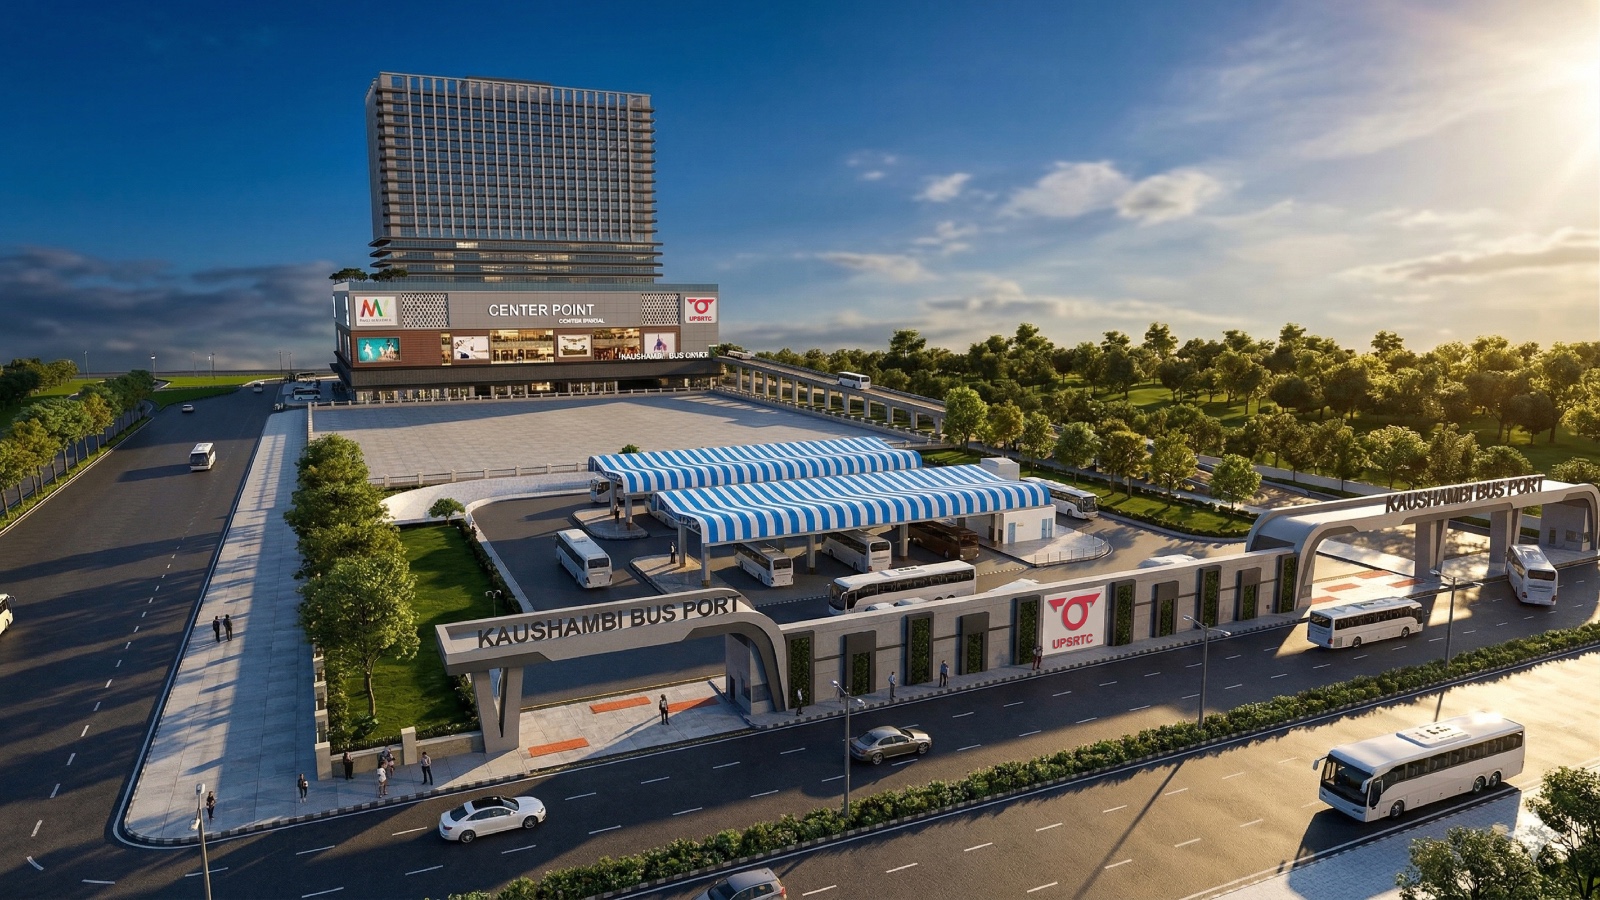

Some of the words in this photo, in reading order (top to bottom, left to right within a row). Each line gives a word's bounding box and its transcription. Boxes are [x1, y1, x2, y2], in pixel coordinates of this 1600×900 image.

[489, 304, 548, 316] CENTER
[552, 304, 595, 316] POINT
[1385, 484, 1474, 513] KAUSHAMBI
[1476, 481, 1505, 500] BUS
[1507, 476, 1545, 496] PORT
[477, 609, 623, 649] KAUSHAMBI
[630, 603, 677, 627] BUS
[683, 594, 742, 619] PORT
[1052, 633, 1094, 650] UPSRTC
